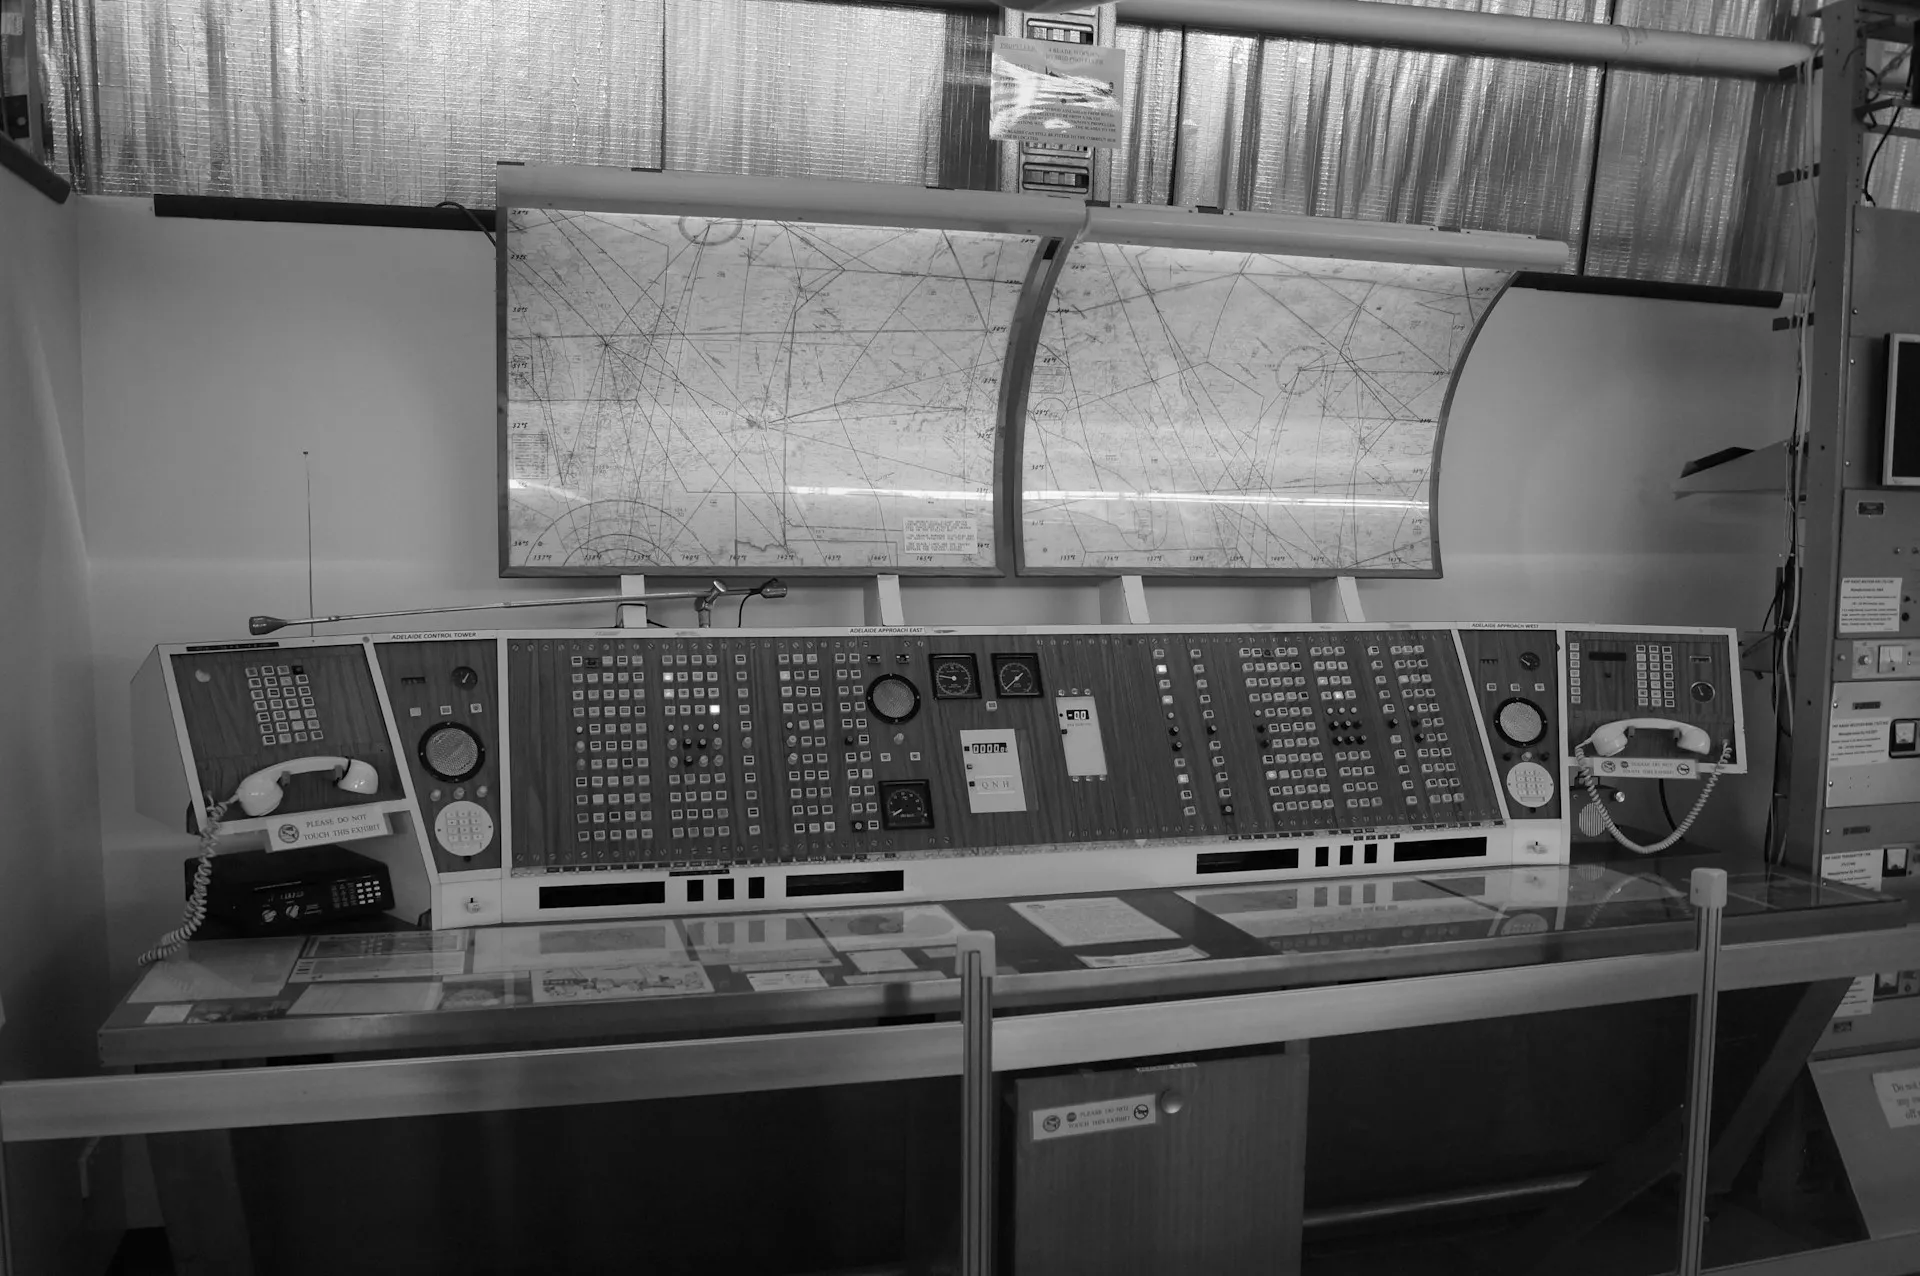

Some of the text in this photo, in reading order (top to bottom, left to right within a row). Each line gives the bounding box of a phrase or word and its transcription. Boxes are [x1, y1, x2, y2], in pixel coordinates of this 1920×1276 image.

[306, 818, 335, 828] PLEASE
[337, 816, 349, 824] DO
[303, 823, 381, 840] TOUCH THIS EXHIBIT
